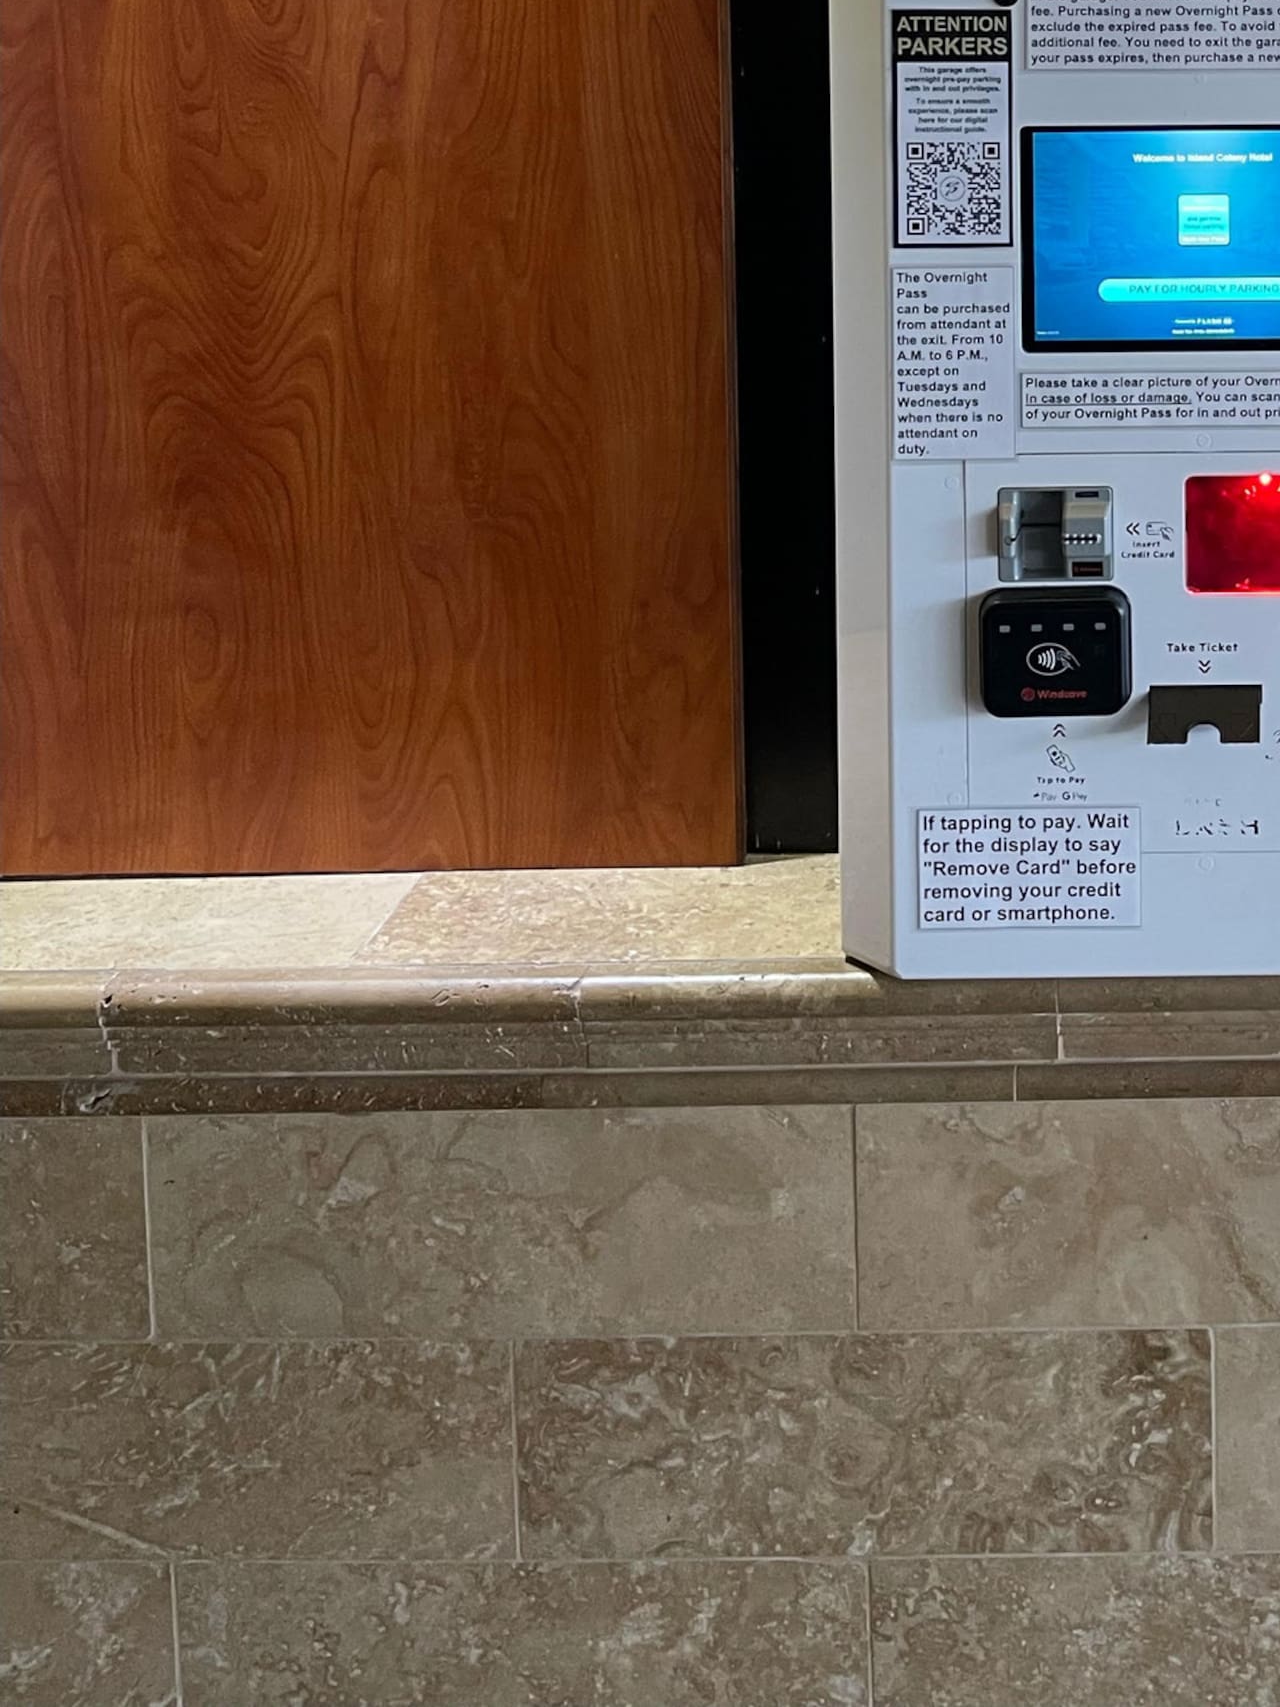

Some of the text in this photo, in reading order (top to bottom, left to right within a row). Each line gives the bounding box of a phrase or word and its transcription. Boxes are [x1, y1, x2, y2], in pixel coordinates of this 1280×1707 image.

[896, 15, 1007, 33] ATTENTION
[897, 36, 1008, 56] PARKERS
[896, 271, 988, 285] The Overnight
[896, 287, 928, 299] Pass
[1128, 284, 1150, 294] PAY
[896, 302, 1011, 317] can be purchased
[1167, 642, 1239, 653] Take Ticket
[1037, 776, 1054, 785] Tap
[1068, 775, 1085, 785] Pay
[923, 813, 1129, 835] If tapping to pay. Wait
[923, 836, 1121, 857] for the display to say
[923, 859, 1137, 877] "Remove Card" before
[923, 881, 1121, 902] removing your credit
[923, 905, 1115, 925] card or smartphone.
